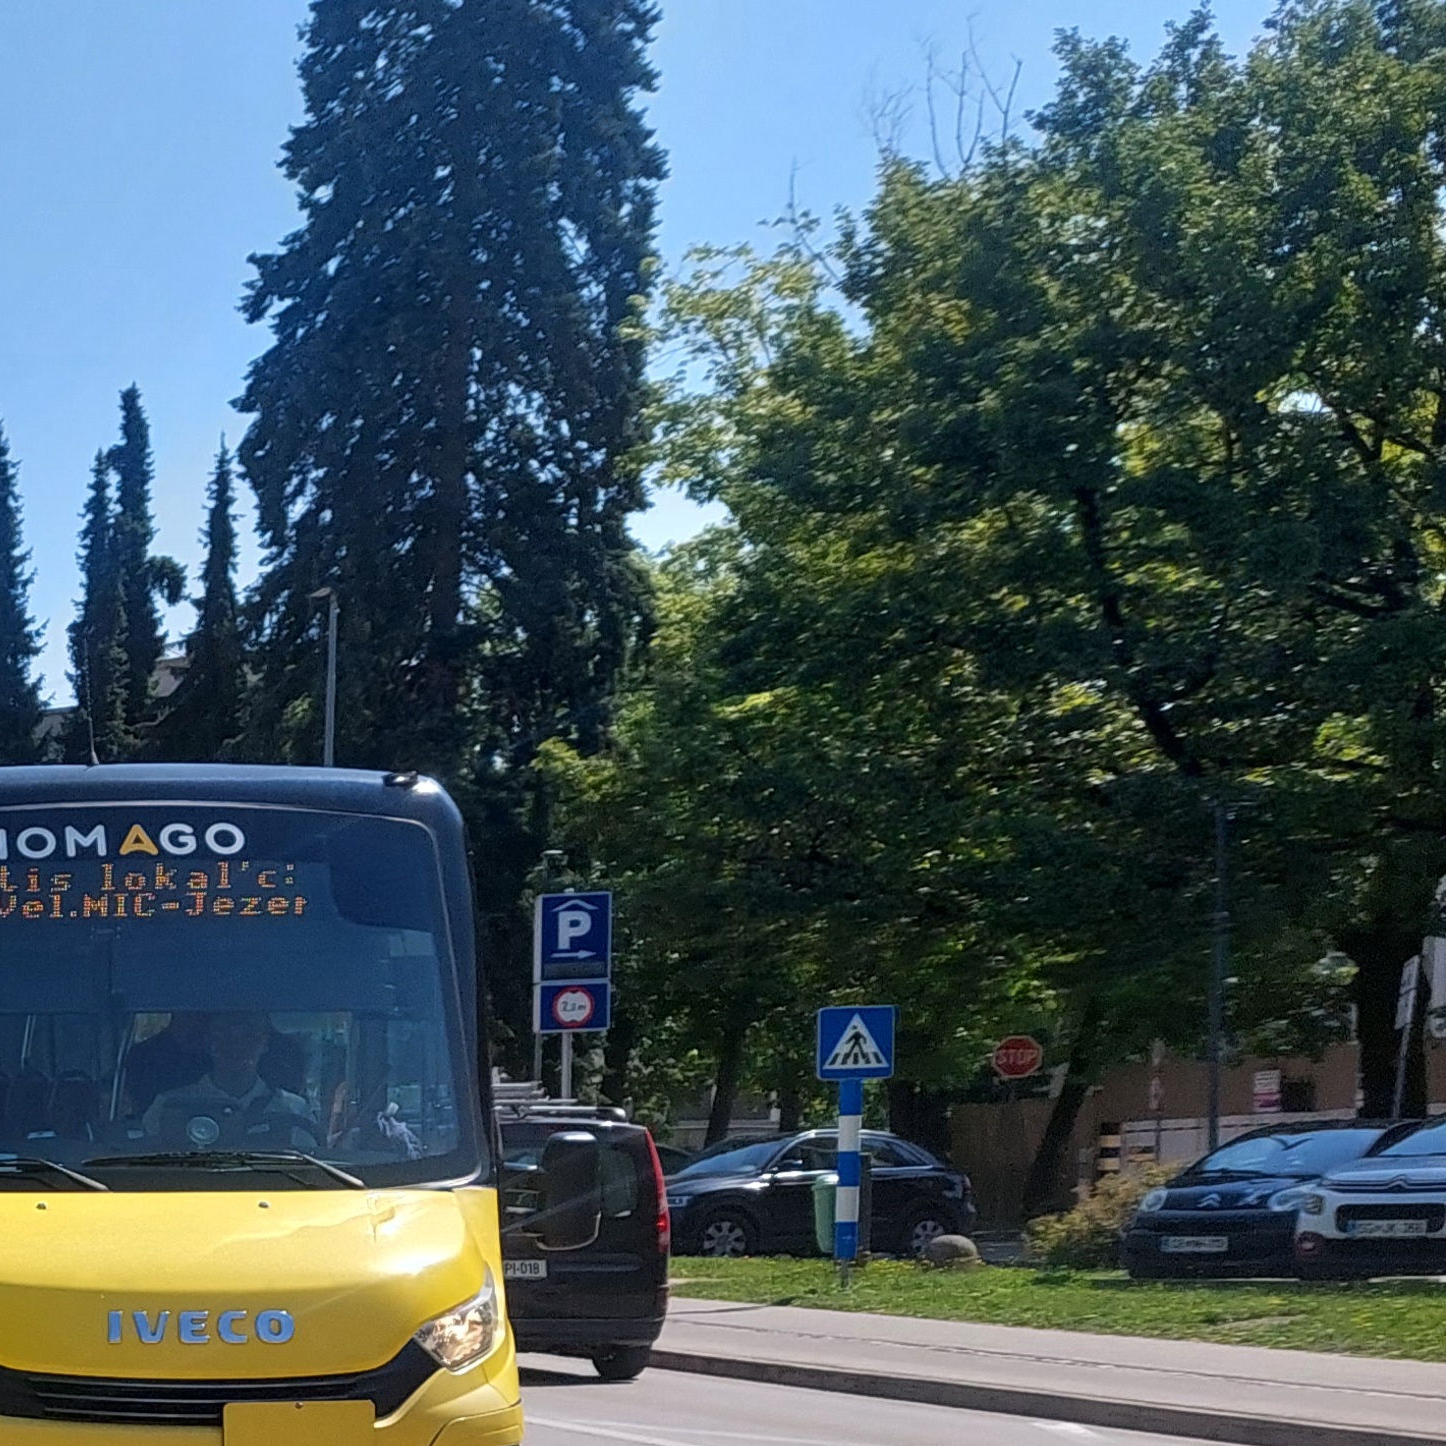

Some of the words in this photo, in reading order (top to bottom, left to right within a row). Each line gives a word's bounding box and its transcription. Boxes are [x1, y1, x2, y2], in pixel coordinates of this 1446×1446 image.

[557, 910, 592, 950] P
[995, 1048, 1038, 1065] STOP
[107, 1309, 296, 1345] IVECO
